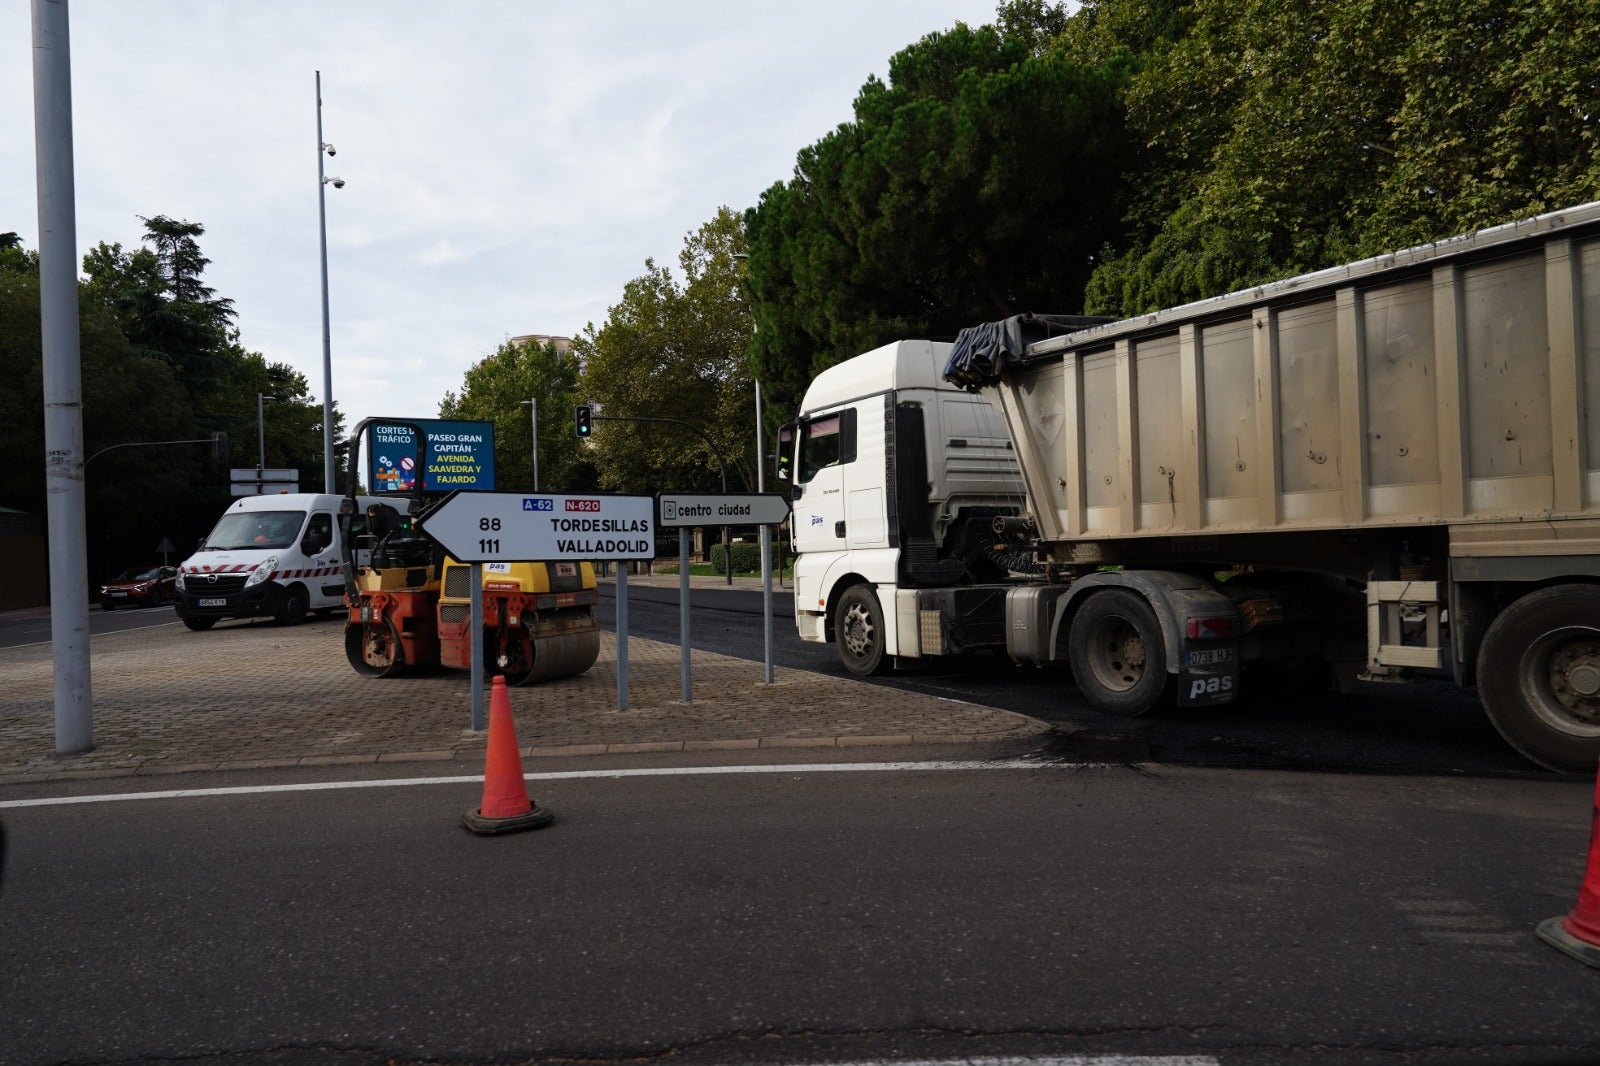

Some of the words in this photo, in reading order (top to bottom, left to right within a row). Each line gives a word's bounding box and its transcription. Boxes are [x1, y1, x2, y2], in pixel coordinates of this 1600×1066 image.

[376, 426, 407, 435] CORTES
[377, 434, 411, 444] TRÁFICO
[428, 434, 456, 442] PASEO
[458, 435, 482, 443] GRAN
[434, 443, 472, 452] CAPITÁN
[437, 455, 475, 463] AVENIDA
[428, 465, 474, 473] SAAVEDRA
[437, 475, 477, 484] FAJARDO
[524, 500, 552, 511] A-62
[566, 501, 600, 511] N-620
[678, 504, 712, 516] centro
[718, 504, 751, 516] ciudad
[479, 517, 501, 531] 88
[551, 518, 649, 532] TORDESILLAS
[479, 538, 500, 553] 111
[557, 540, 649, 553] VALLADOLID
[1189, 675, 1233, 699] pas
